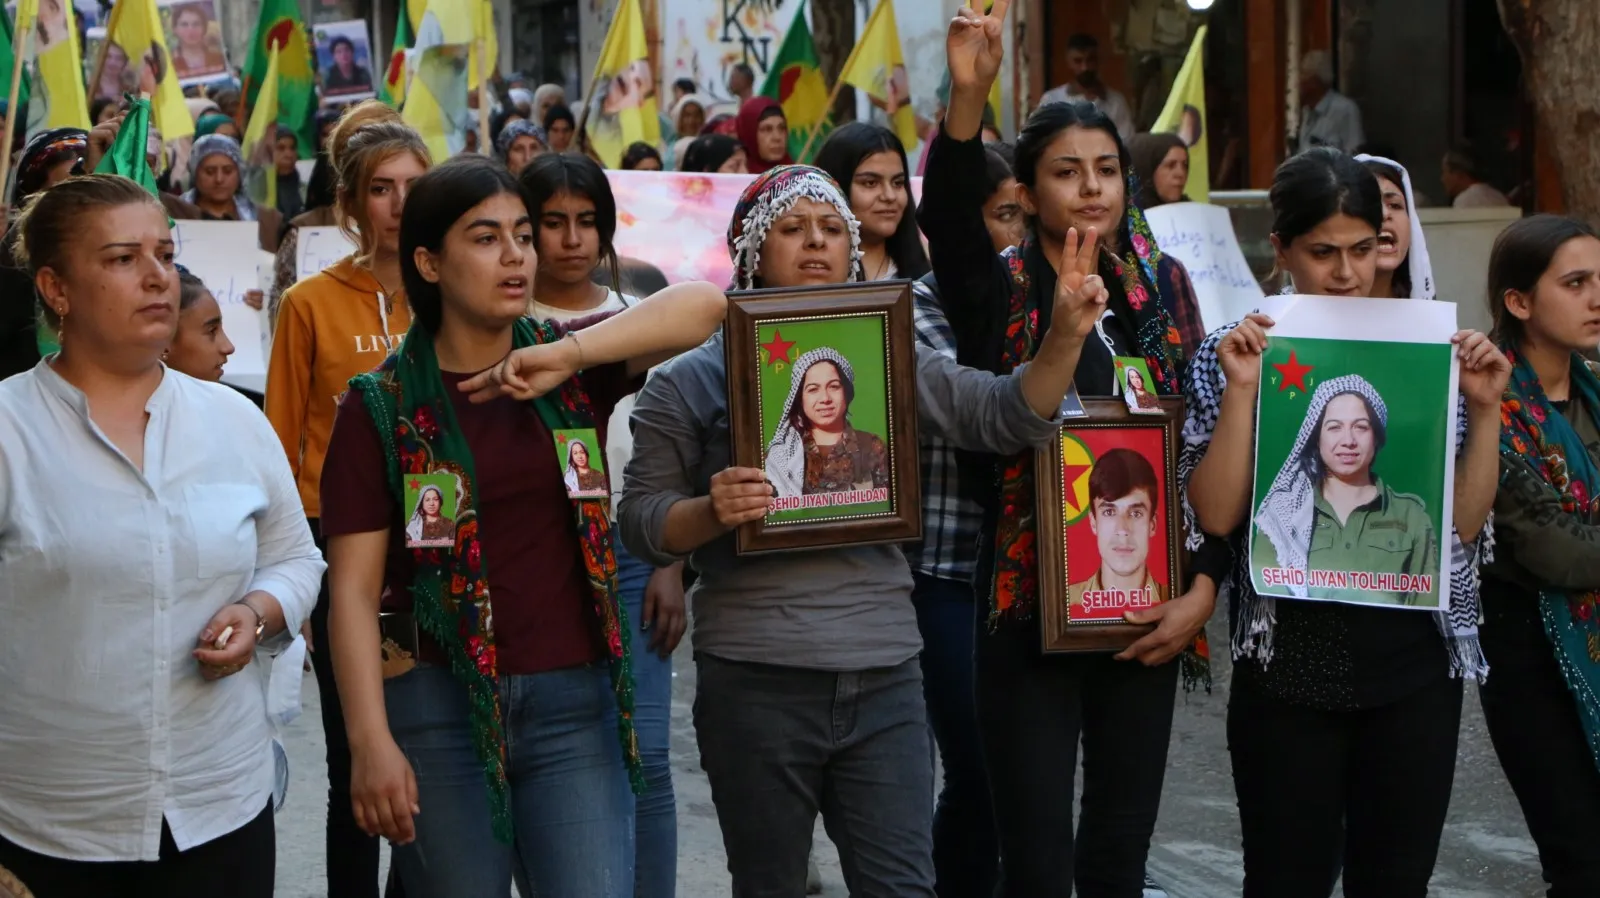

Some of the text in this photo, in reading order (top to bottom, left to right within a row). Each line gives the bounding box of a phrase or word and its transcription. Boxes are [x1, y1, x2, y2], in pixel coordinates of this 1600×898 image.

[775, 362, 785, 374] P
[1271, 376, 1278, 385] Y
[1289, 391, 1296, 400] P
[801, 492, 829, 509] JIYAN
[831, 488, 887, 505] TOLHILDAN
[1262, 566, 1432, 593] ŞEHÎD JIYAN TOLHILDAN
[1082, 584, 1152, 613] ŞEHÎD ELÎ
